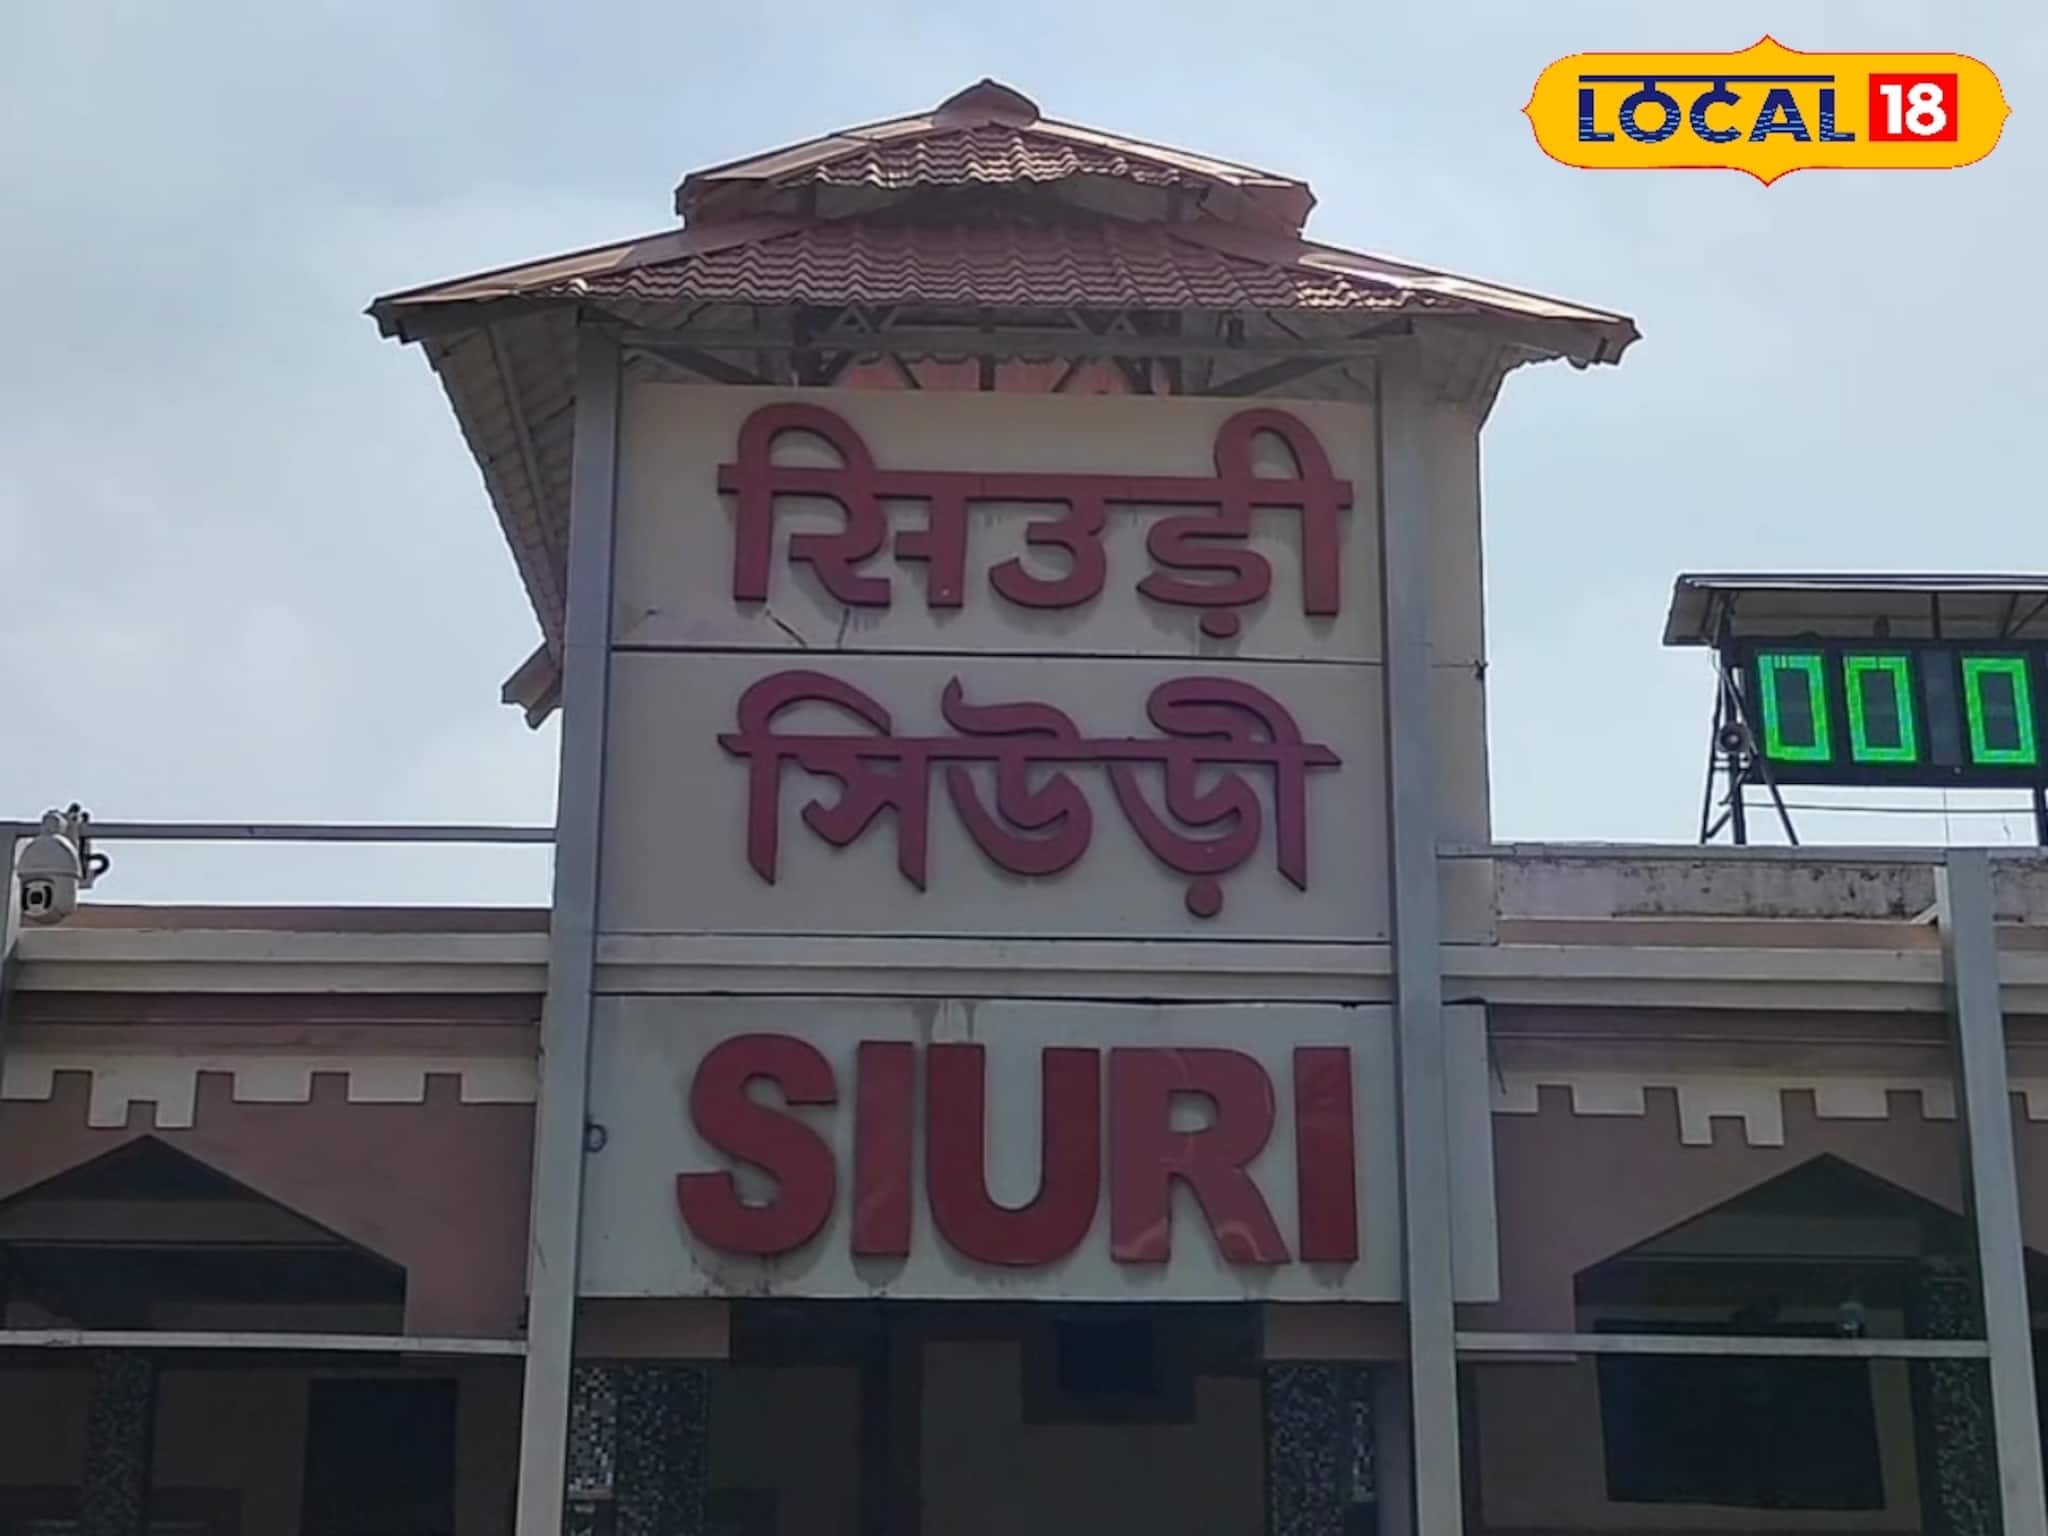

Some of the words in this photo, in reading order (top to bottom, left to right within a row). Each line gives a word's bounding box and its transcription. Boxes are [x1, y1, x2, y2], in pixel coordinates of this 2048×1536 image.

[717, 402, 1354, 638] सिउड़ी
[717, 669, 1342, 918] সিউড়ী
[676, 1033, 1359, 1267] SIURI
